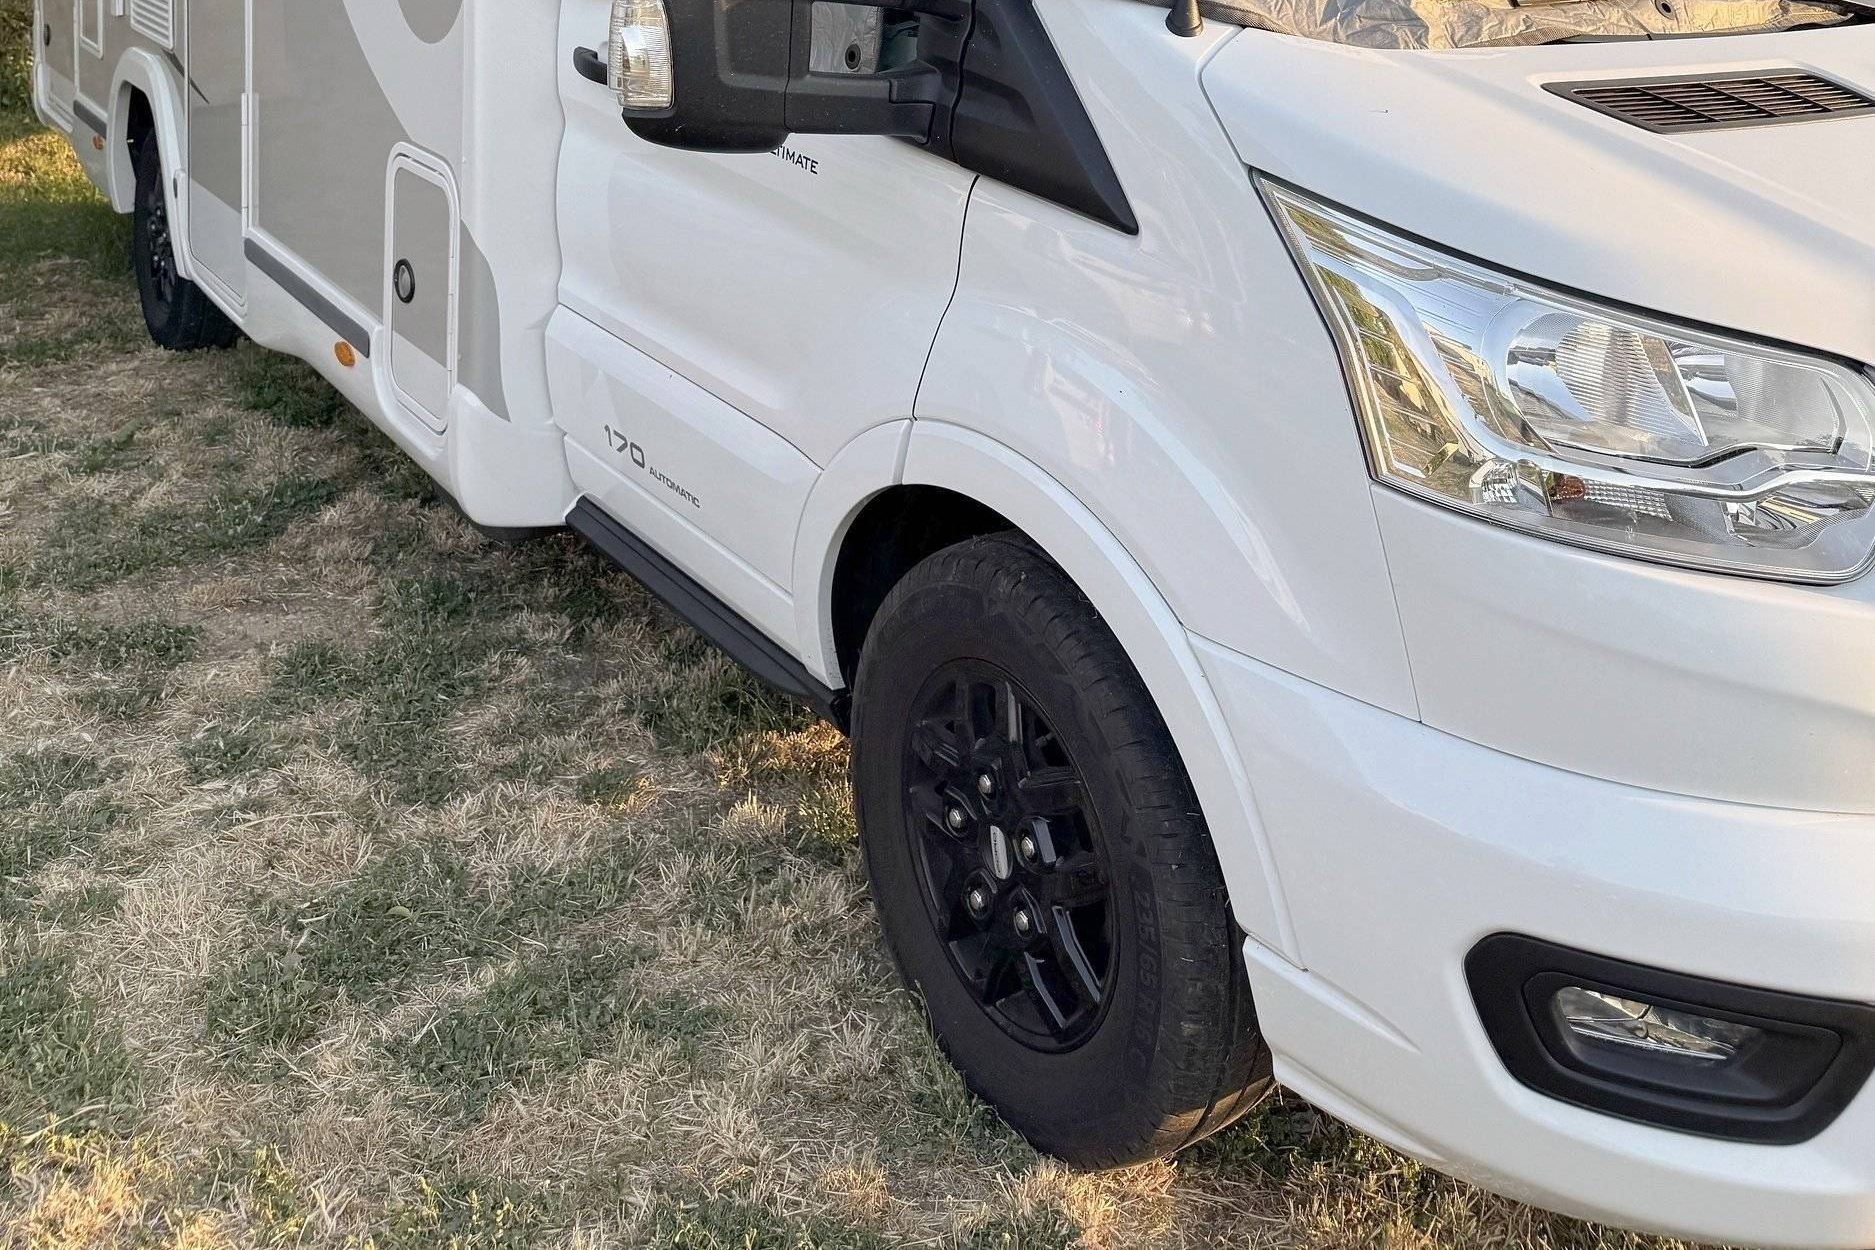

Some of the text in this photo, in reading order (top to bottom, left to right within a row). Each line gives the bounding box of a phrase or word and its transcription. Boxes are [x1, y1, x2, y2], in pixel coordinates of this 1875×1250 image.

[770, 146, 819, 175] TIMATE
[604, 424, 700, 509] 170 AUTOMATIC
[1133, 890, 1158, 989] 235/65
